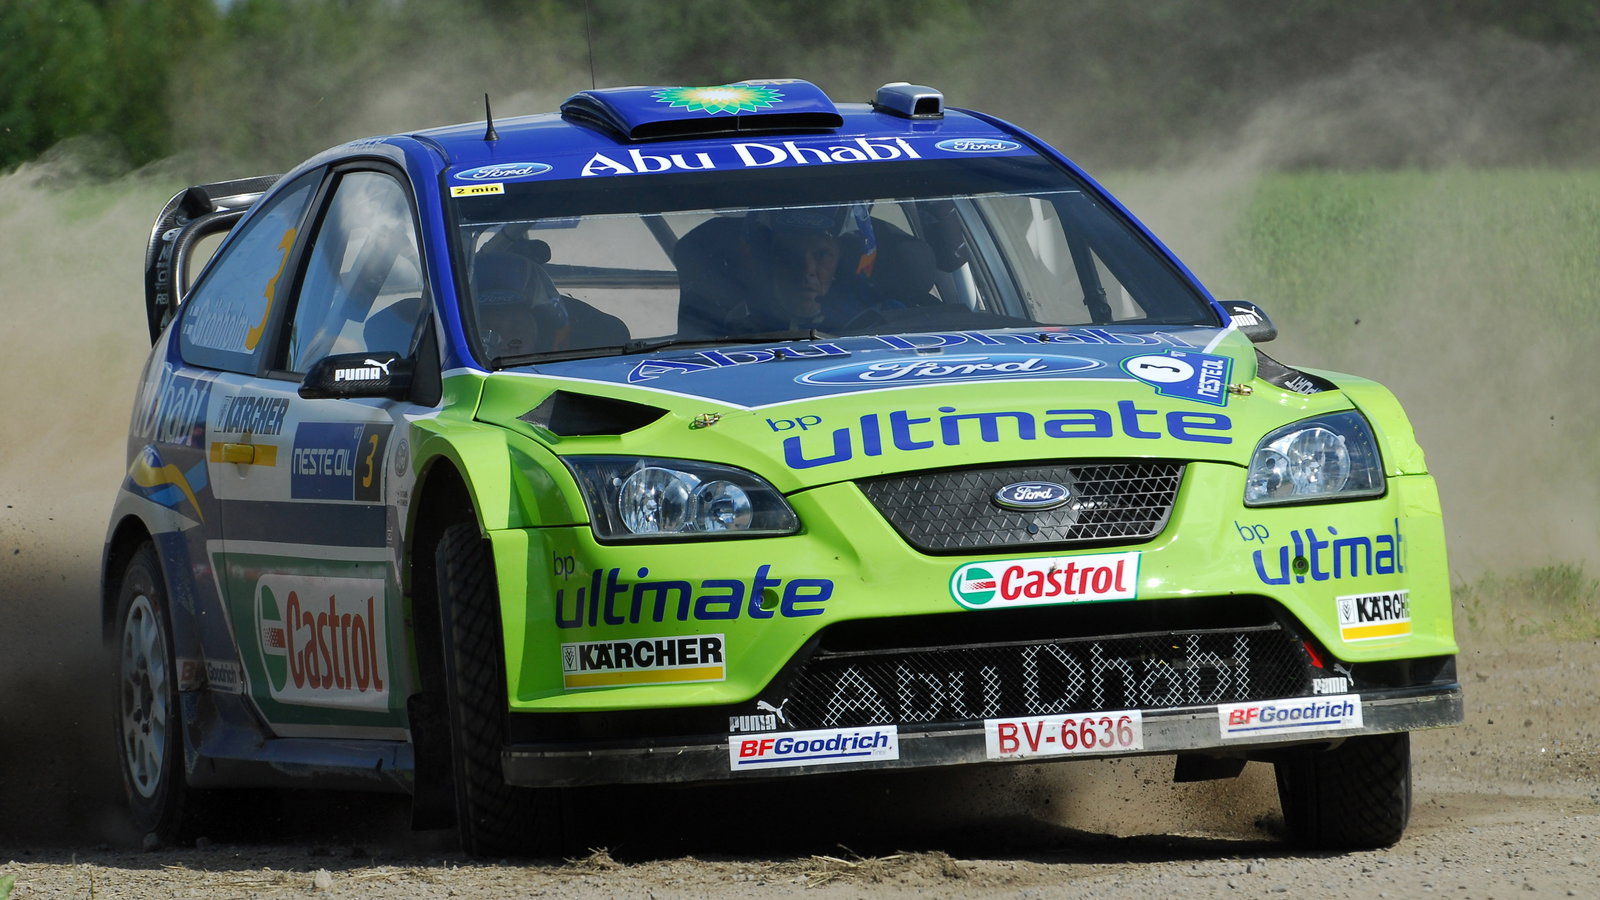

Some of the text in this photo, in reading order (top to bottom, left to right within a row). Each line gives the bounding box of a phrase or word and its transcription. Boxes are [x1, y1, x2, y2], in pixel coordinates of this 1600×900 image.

[581, 137, 921, 177] Abu Dhabi
[953, 140, 1007, 151] Ford
[473, 165, 533, 179] Ford
[471, 186, 499, 194] min
[628, 328, 1197, 383] Abu Dhabi
[859, 357, 1048, 379] Ford
[334, 368, 381, 382] PUMA
[1197, 368, 1222, 398] NESTE
[222, 396, 290, 436] KÄRCHER
[767, 413, 822, 433] bp
[783, 399, 1233, 469] ultimate
[293, 448, 353, 477] NESTE OIL
[362, 434, 378, 488] 3
[1013, 486, 1053, 501] Ford
[1234, 520, 1270, 544] bp
[553, 550, 575, 581] bp
[1252, 517, 1408, 586] ultimat
[1001, 560, 1126, 601] Castrol
[555, 564, 834, 629] ultimate
[1356, 592, 1411, 623] KÄRCH
[286, 590, 383, 692] Castrol
[580, 638, 723, 671] KÄRCHER
[1020, 632, 1251, 714] Dhabi
[1313, 677, 1348, 695] PUMA
[729, 714, 776, 732] PUMA
[1228, 700, 1354, 726] BFGoodrich
[739, 732, 889, 758] BFGoodrich
[997, 716, 1134, 754] BV-6636
